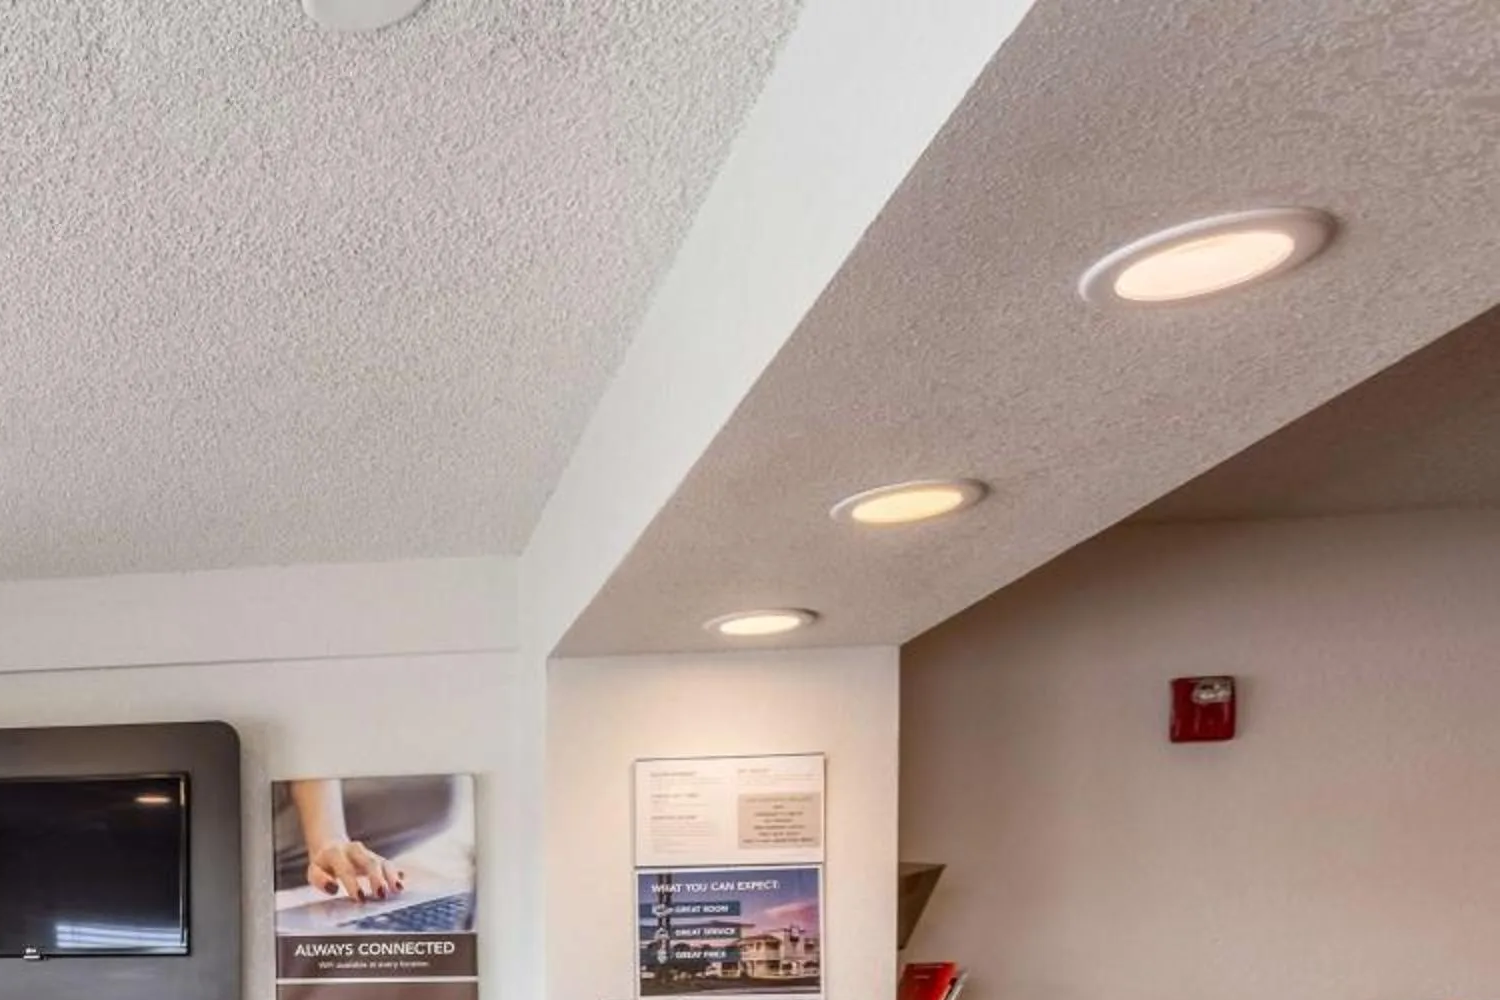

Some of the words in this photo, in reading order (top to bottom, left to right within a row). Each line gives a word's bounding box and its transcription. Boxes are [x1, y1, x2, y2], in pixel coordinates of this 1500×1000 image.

[651, 883, 682, 893] WHAT
[685, 883, 708, 892] YOU
[711, 881, 735, 891] CAN
[675, 905, 702, 913] GREAT
[703, 905, 729, 913] ROOM
[675, 928, 701, 937] GREAT
[294, 943, 353, 957] ALWAYS
[357, 941, 456, 956] CONNECTED
